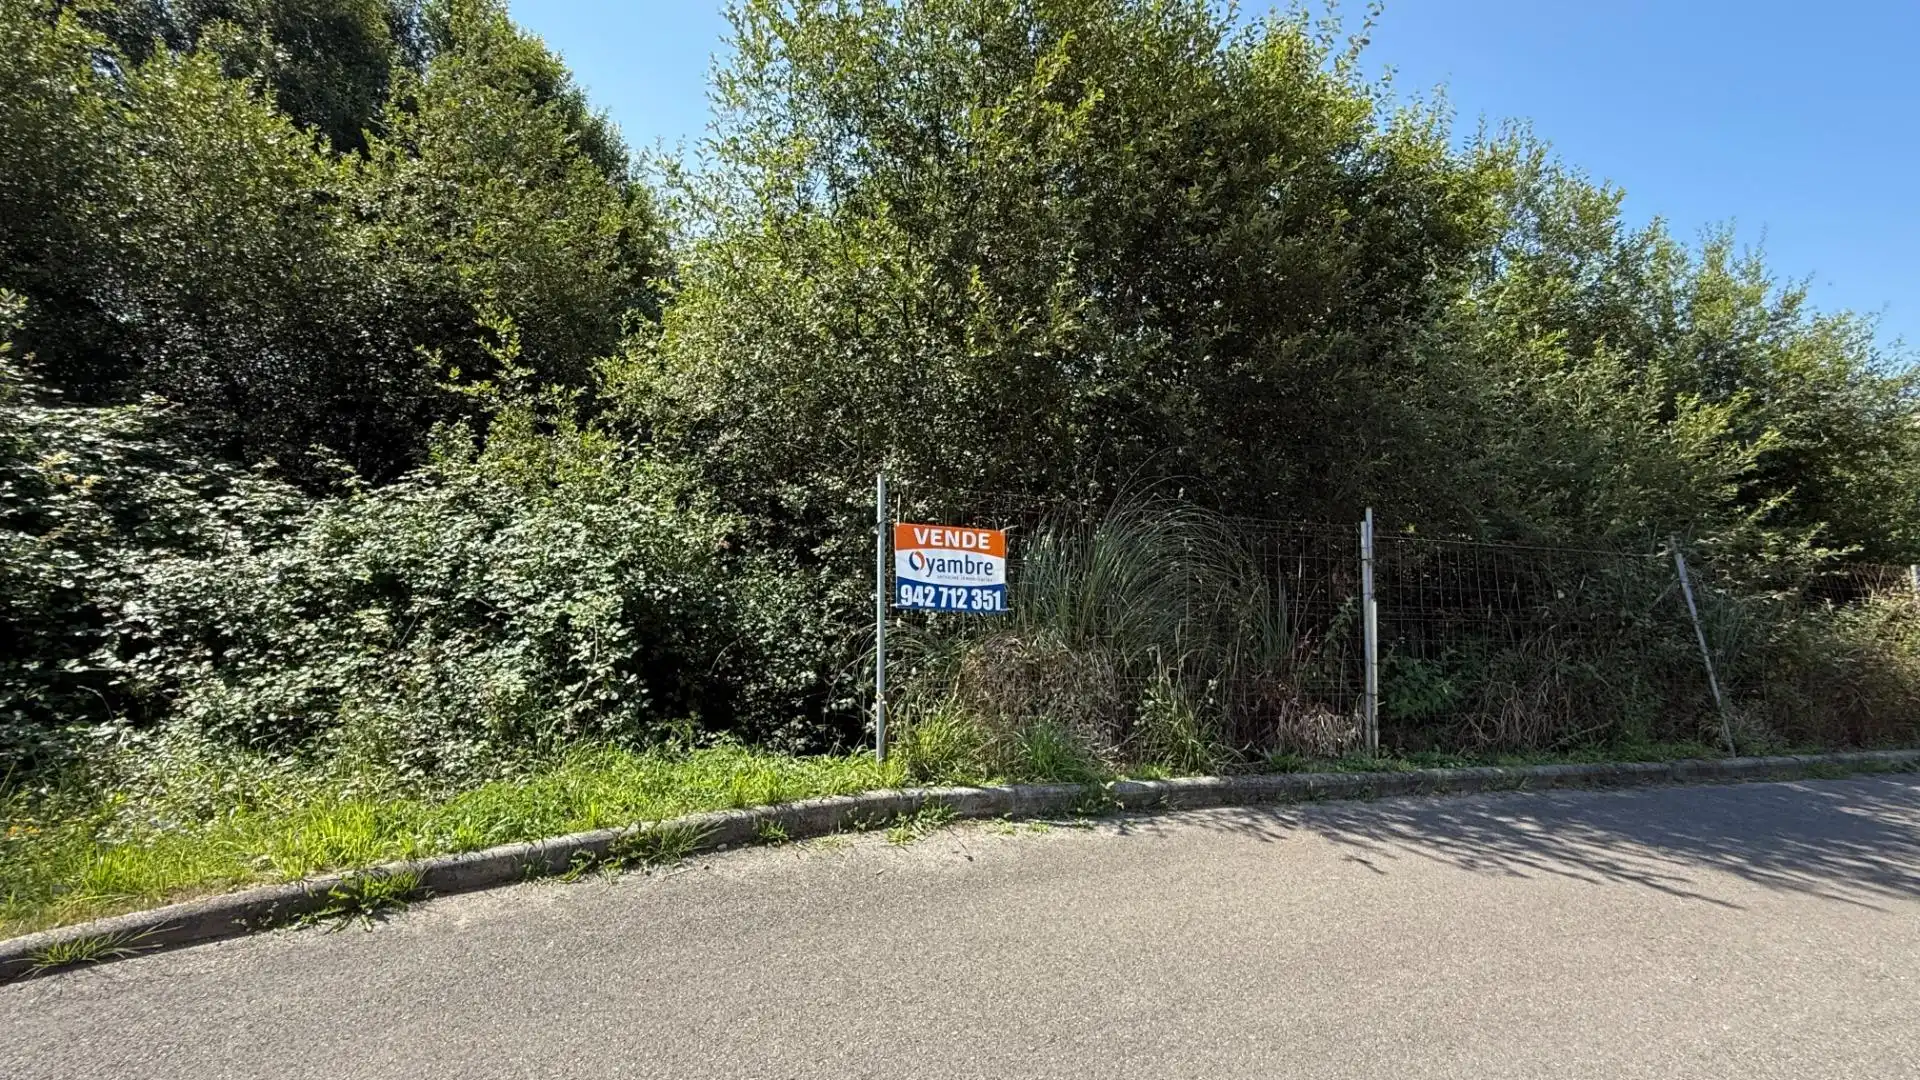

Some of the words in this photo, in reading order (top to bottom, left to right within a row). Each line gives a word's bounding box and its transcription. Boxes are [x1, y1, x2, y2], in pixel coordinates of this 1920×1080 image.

[913, 528, 991, 549] VENDE
[909, 551, 993, 577] Oyambre
[900, 585, 936, 607] 942
[938, 586, 968, 609] 712
[971, 589, 1001, 611] 351
